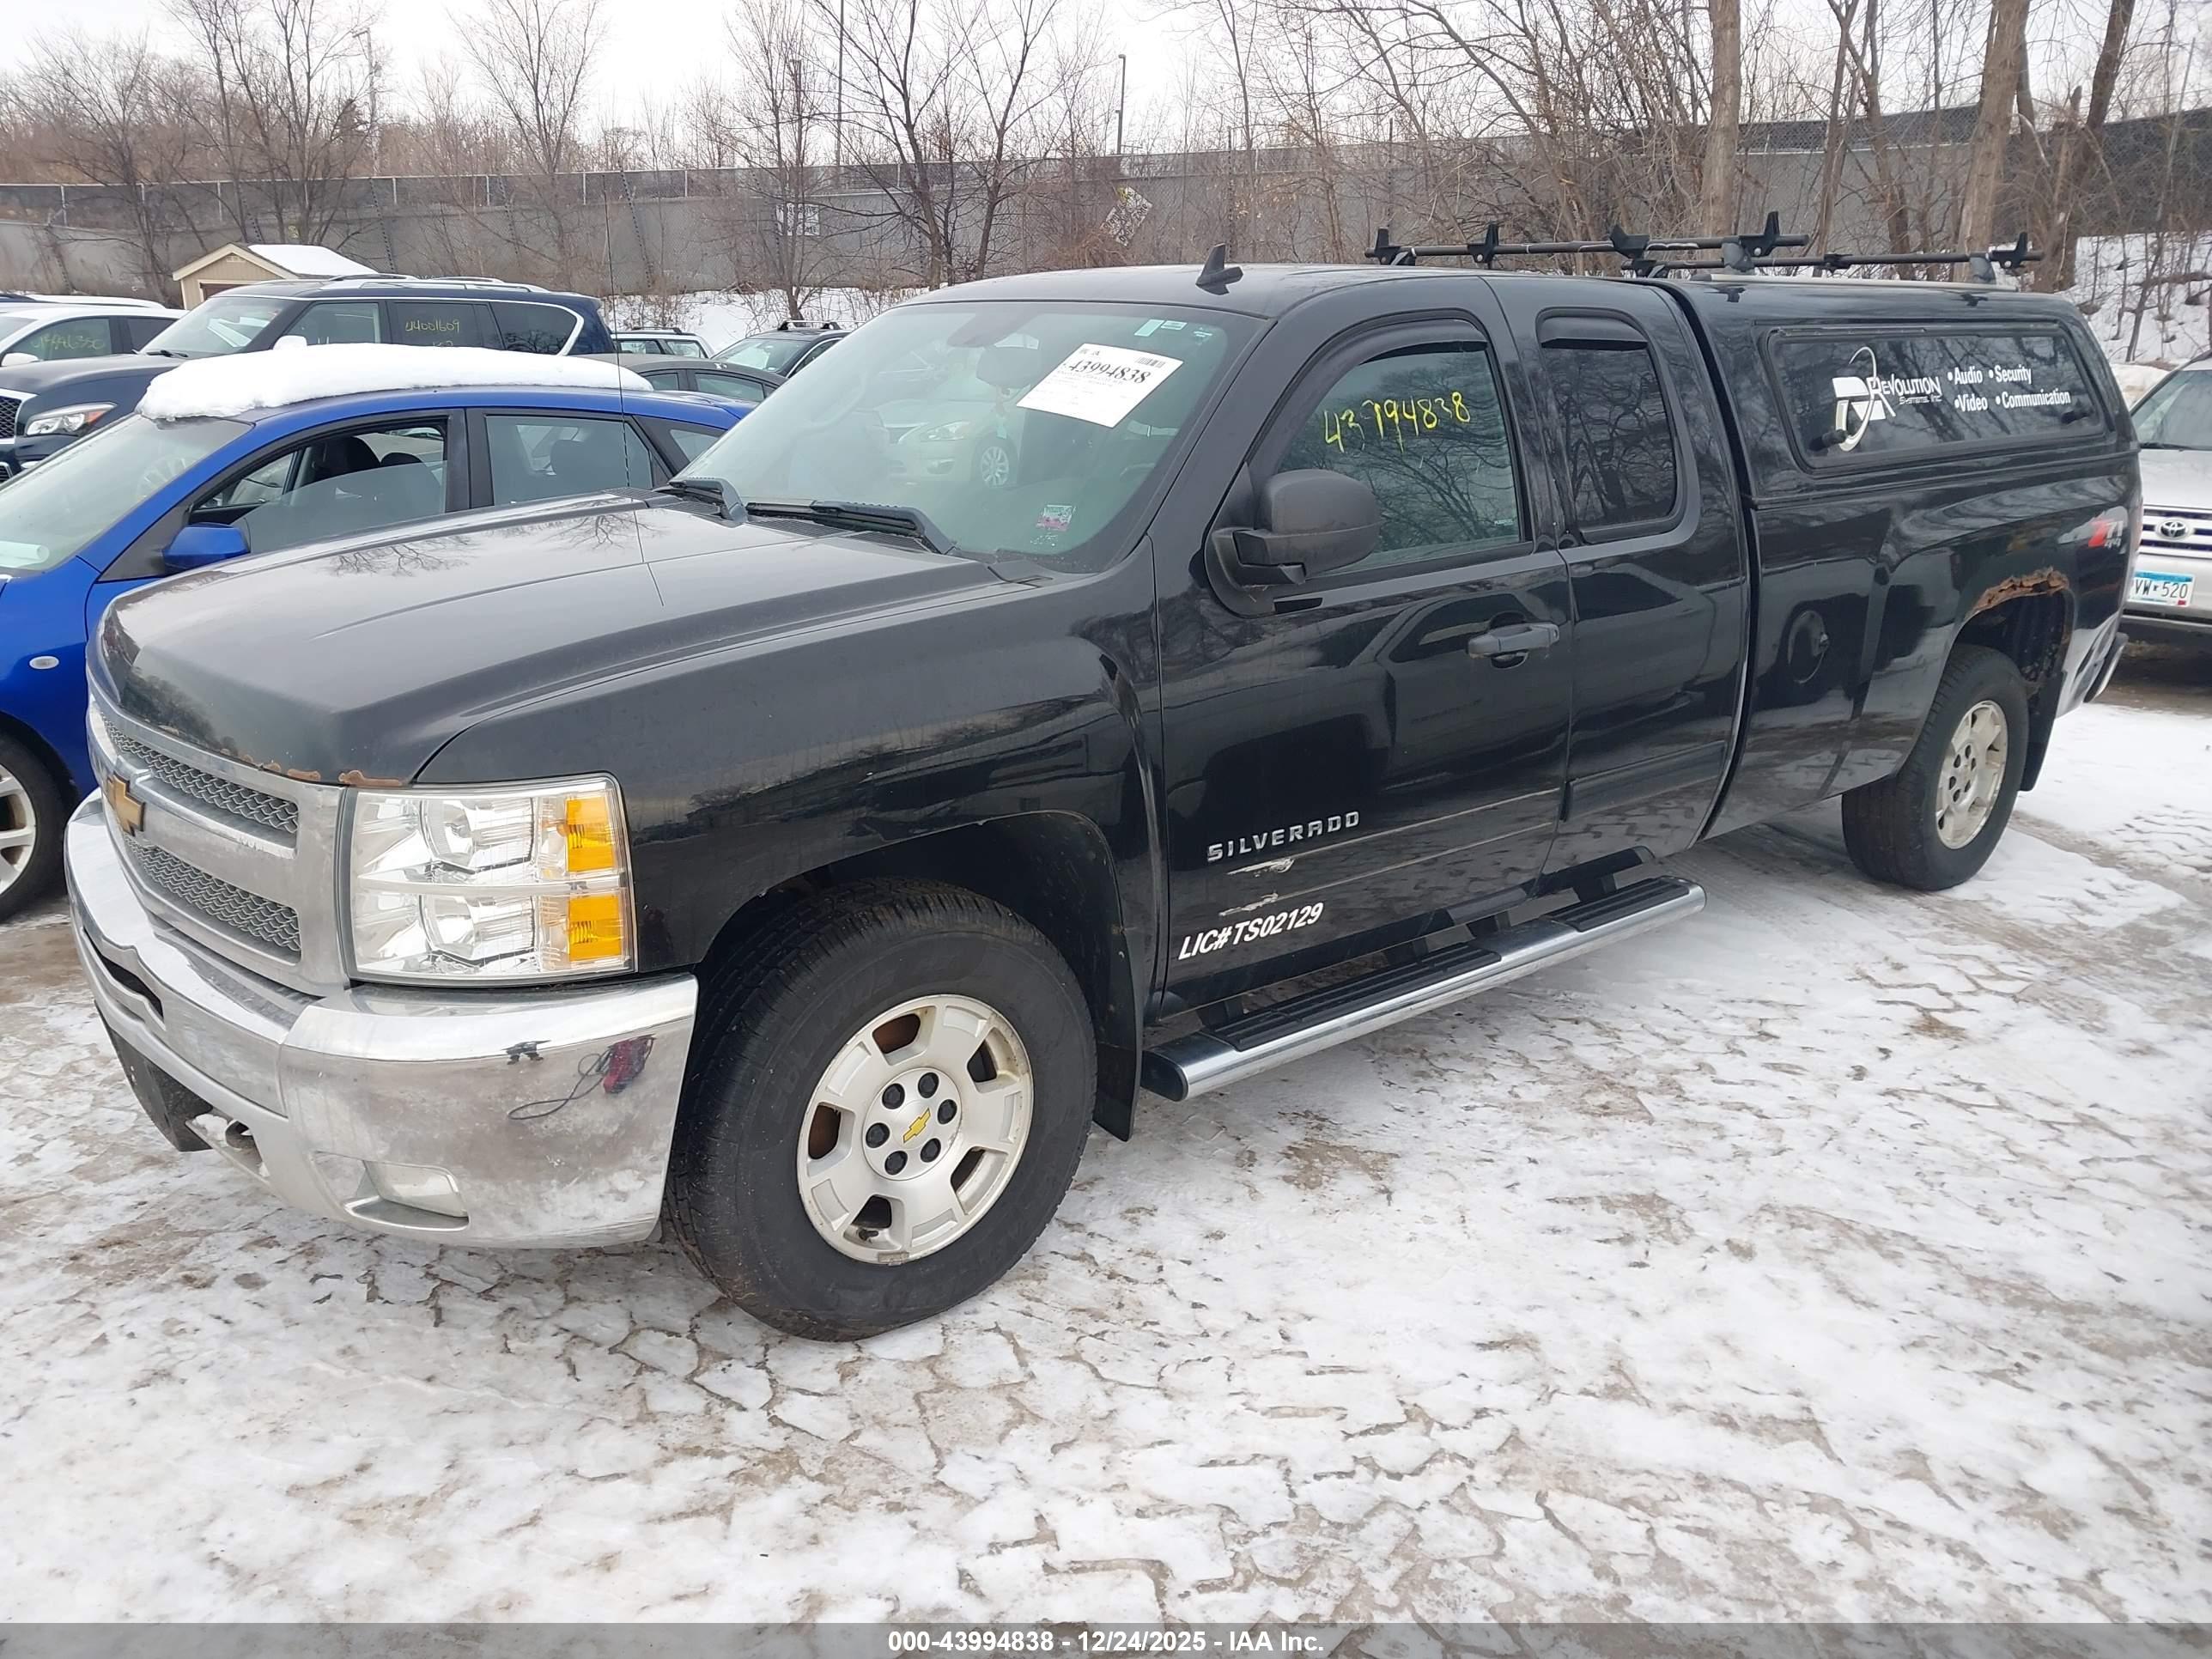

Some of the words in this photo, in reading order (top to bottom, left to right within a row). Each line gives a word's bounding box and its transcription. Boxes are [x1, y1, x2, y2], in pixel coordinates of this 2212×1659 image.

[1067, 358, 1152, 384] 43994838
[1954, 366, 1984, 385] Audio
[1994, 364, 2033, 385] Security
[1957, 392, 1989, 412] Video
[2001, 388, 2072, 409] Communication
[2132, 579, 2153, 596] VW
[1206, 811, 1360, 862] SILVERADO
[1177, 902, 1324, 961] LIC#TS02129
